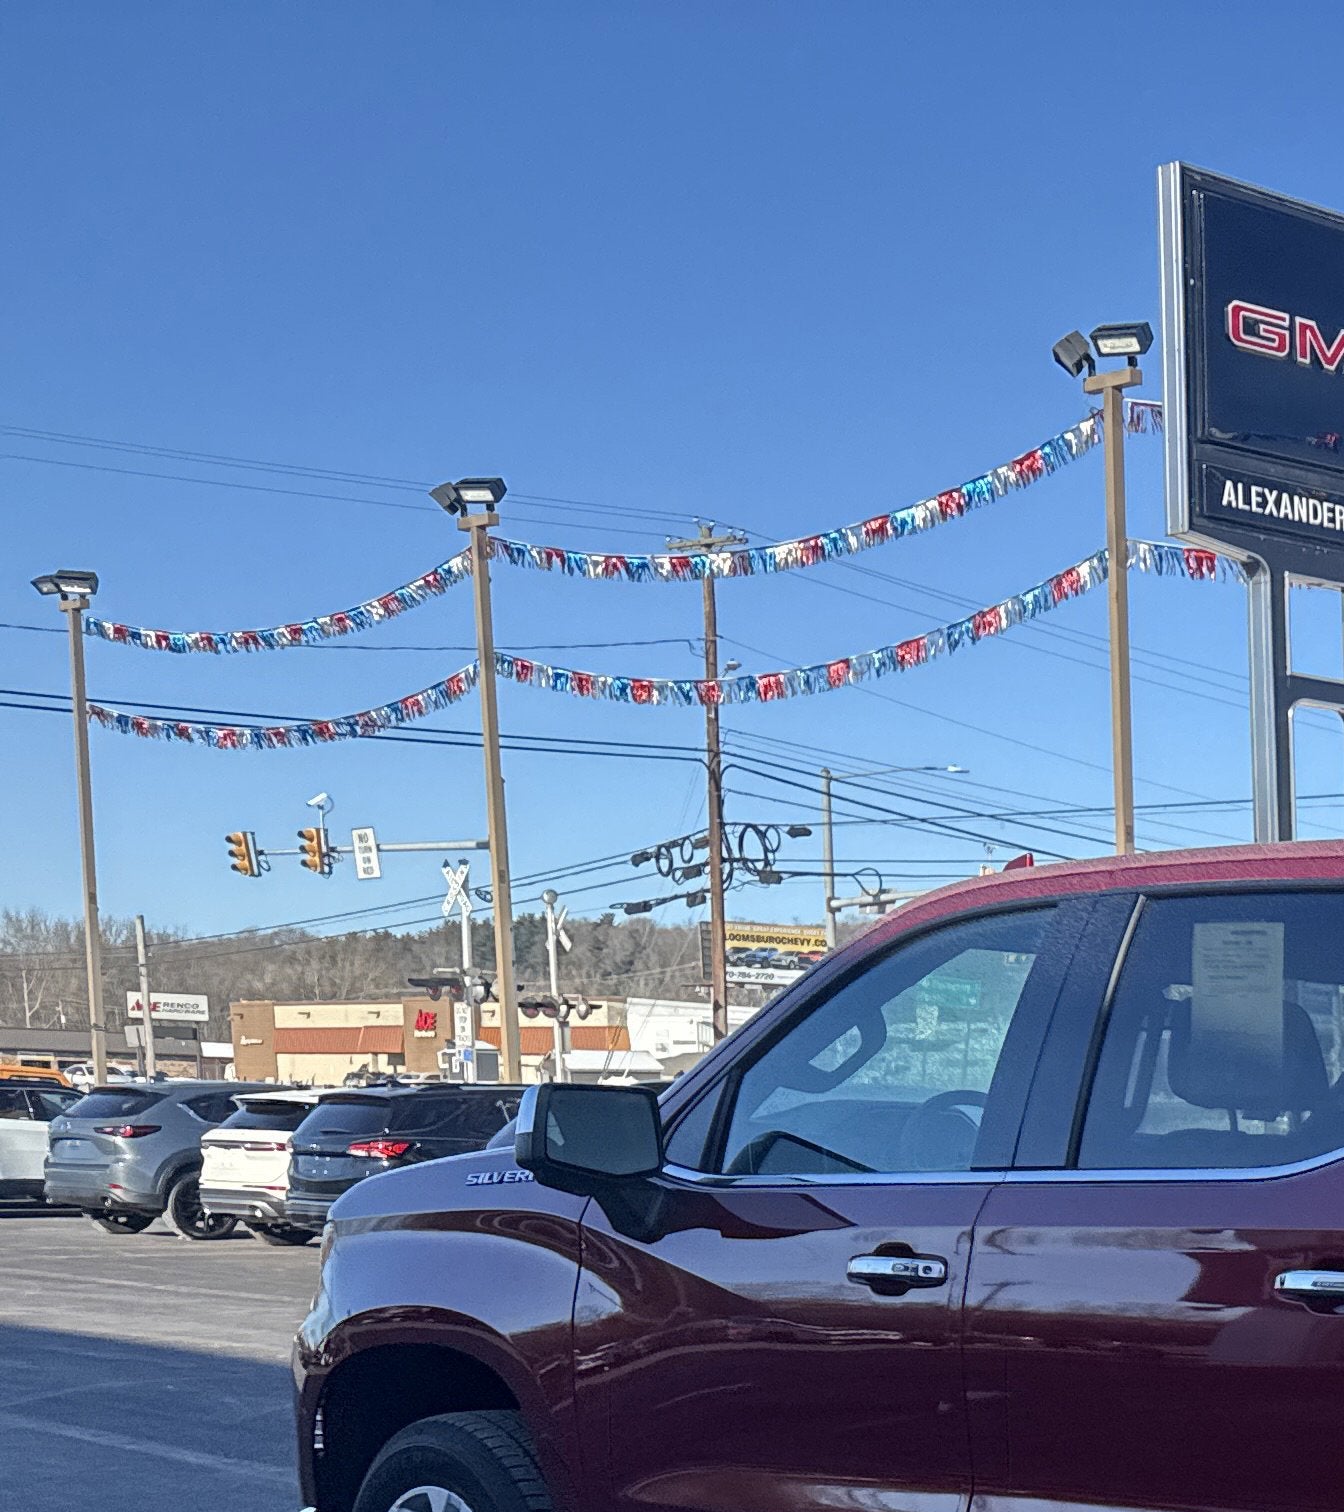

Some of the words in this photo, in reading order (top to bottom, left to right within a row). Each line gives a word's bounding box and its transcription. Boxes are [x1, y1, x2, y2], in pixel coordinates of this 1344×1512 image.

[357, 832, 368, 844] NO
[130, 999, 162, 1012] AE
[465, 1169, 534, 1186] SILVER
